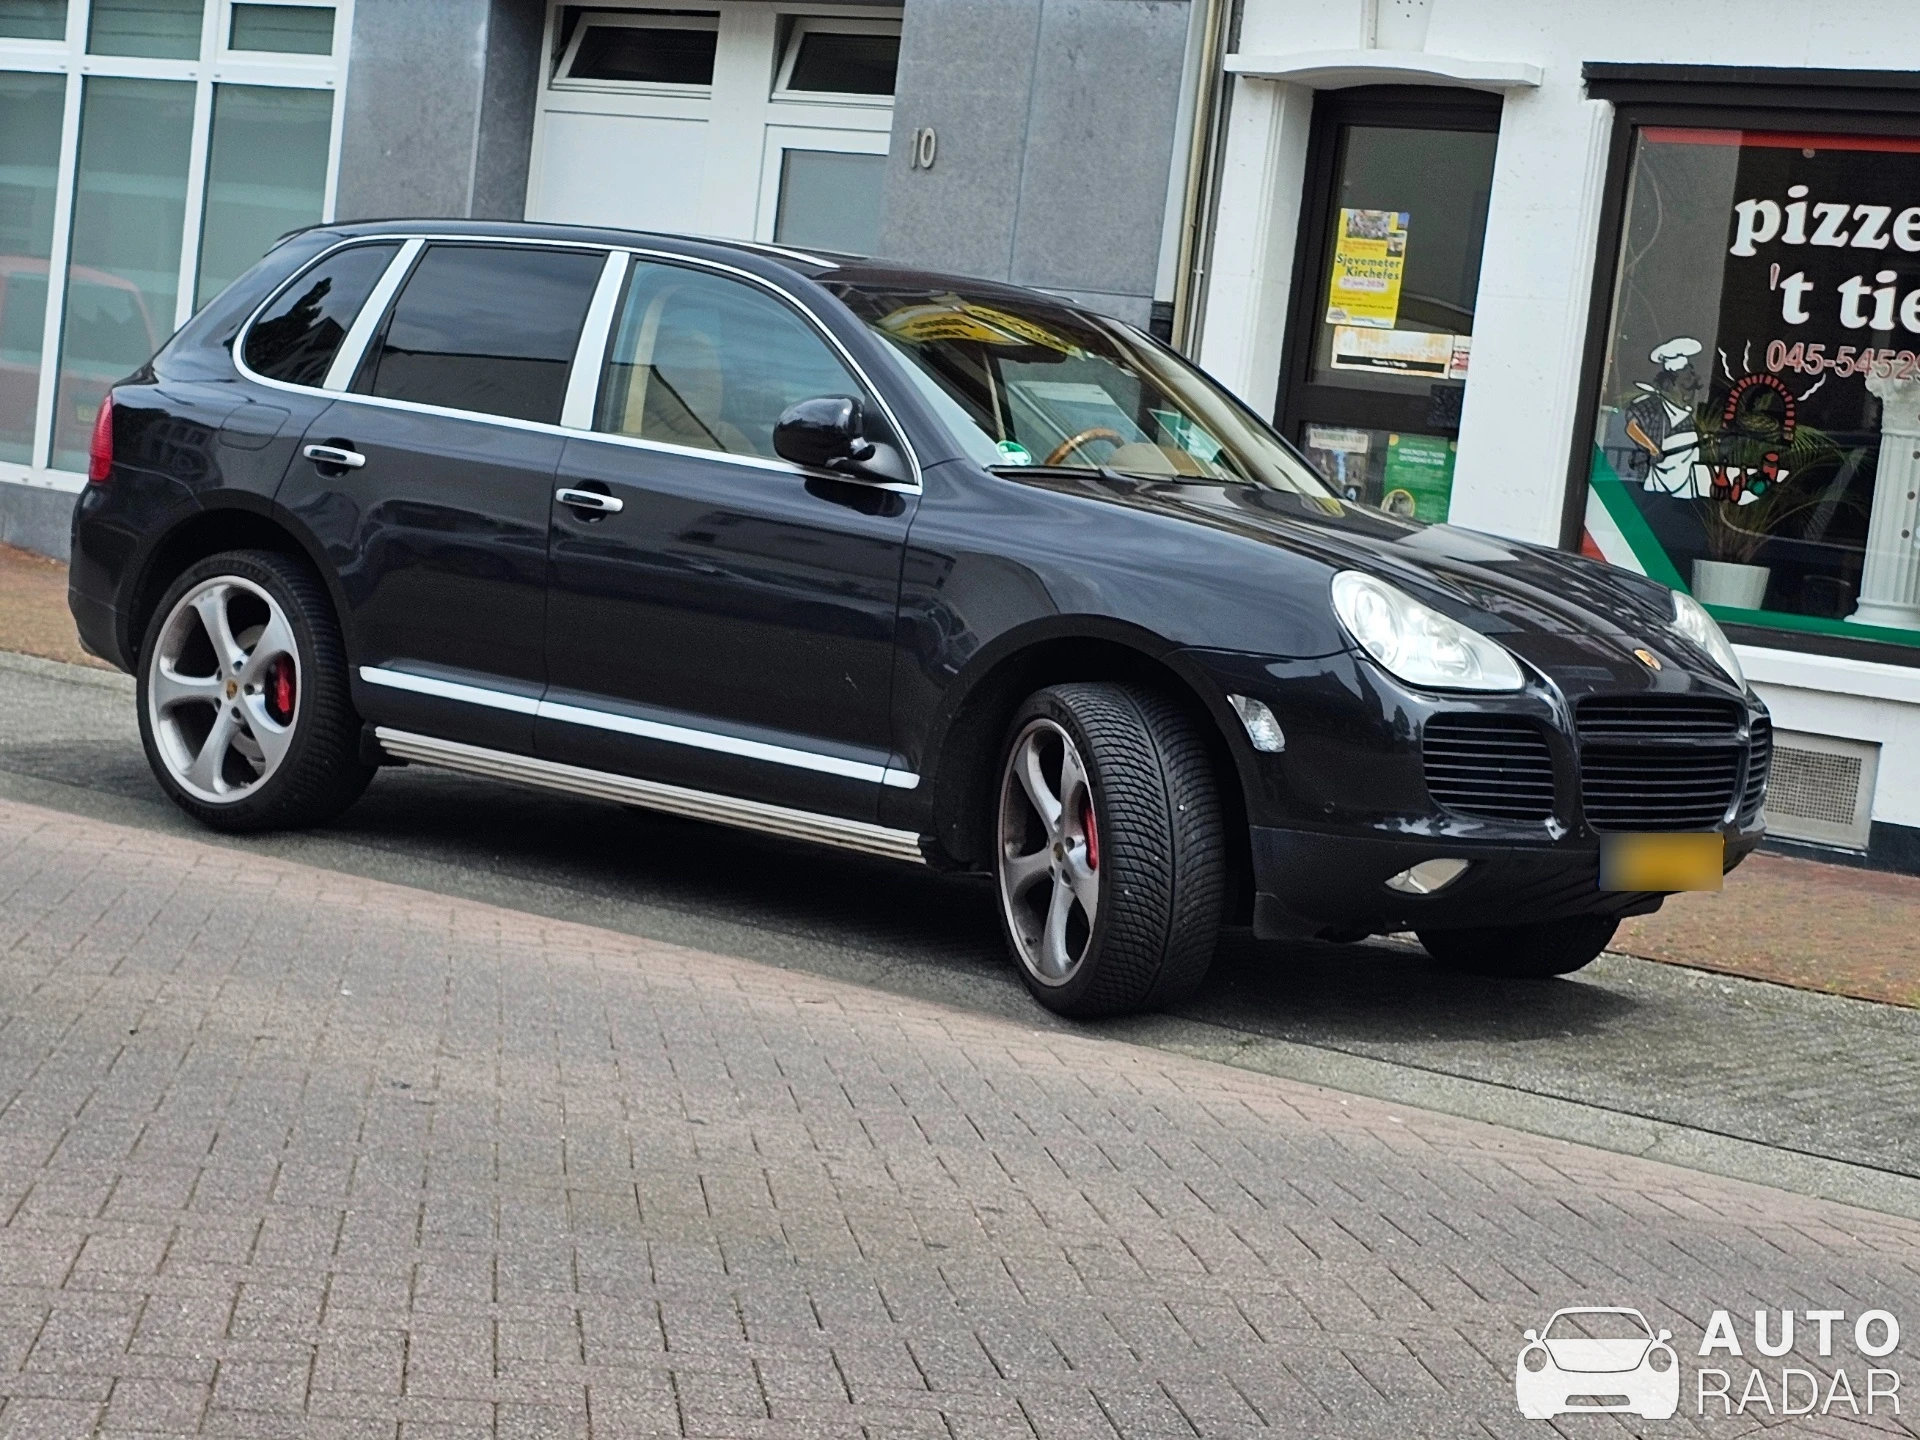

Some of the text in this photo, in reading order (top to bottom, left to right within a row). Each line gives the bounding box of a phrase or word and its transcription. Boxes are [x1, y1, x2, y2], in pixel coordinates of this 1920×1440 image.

[909, 127, 936, 168] 10
[1729, 184, 1920, 257] pizze
[1769, 262, 1814, 325] 't
[1765, 339, 1920, 381] 045-5452
